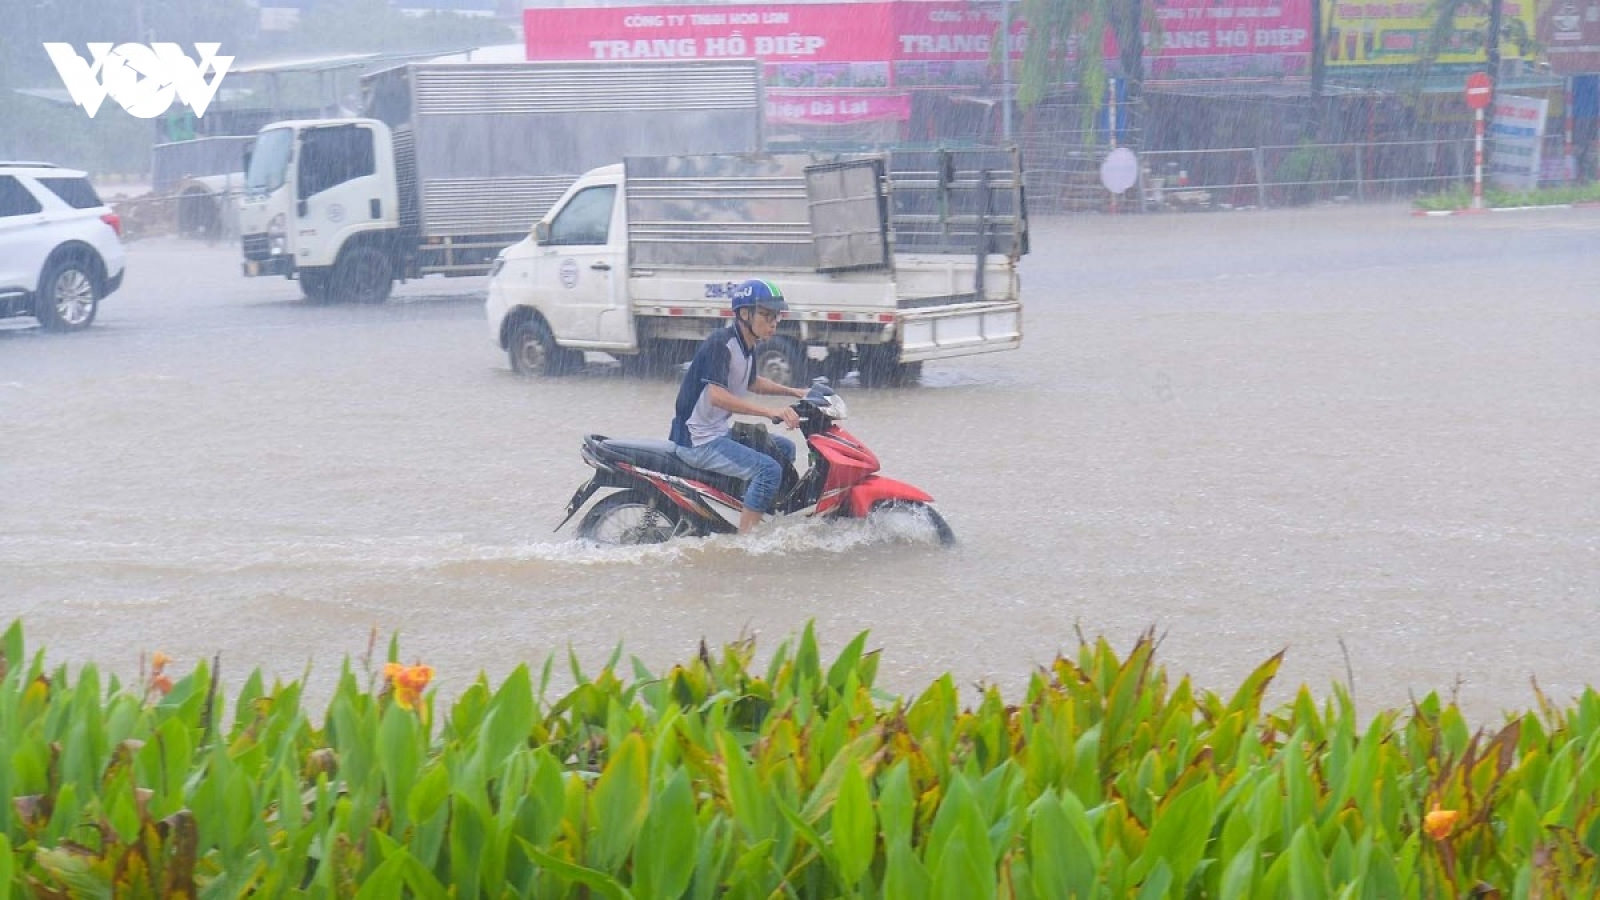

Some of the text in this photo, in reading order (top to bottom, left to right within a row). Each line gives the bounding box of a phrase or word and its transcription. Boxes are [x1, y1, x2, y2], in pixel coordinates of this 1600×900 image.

[625, 14, 663, 27] CÔNG
[668, 16, 685, 26] TY
[590, 30, 825, 59] TRANG HỒ ĐIỆP
[899, 34, 989, 53] TRANG
